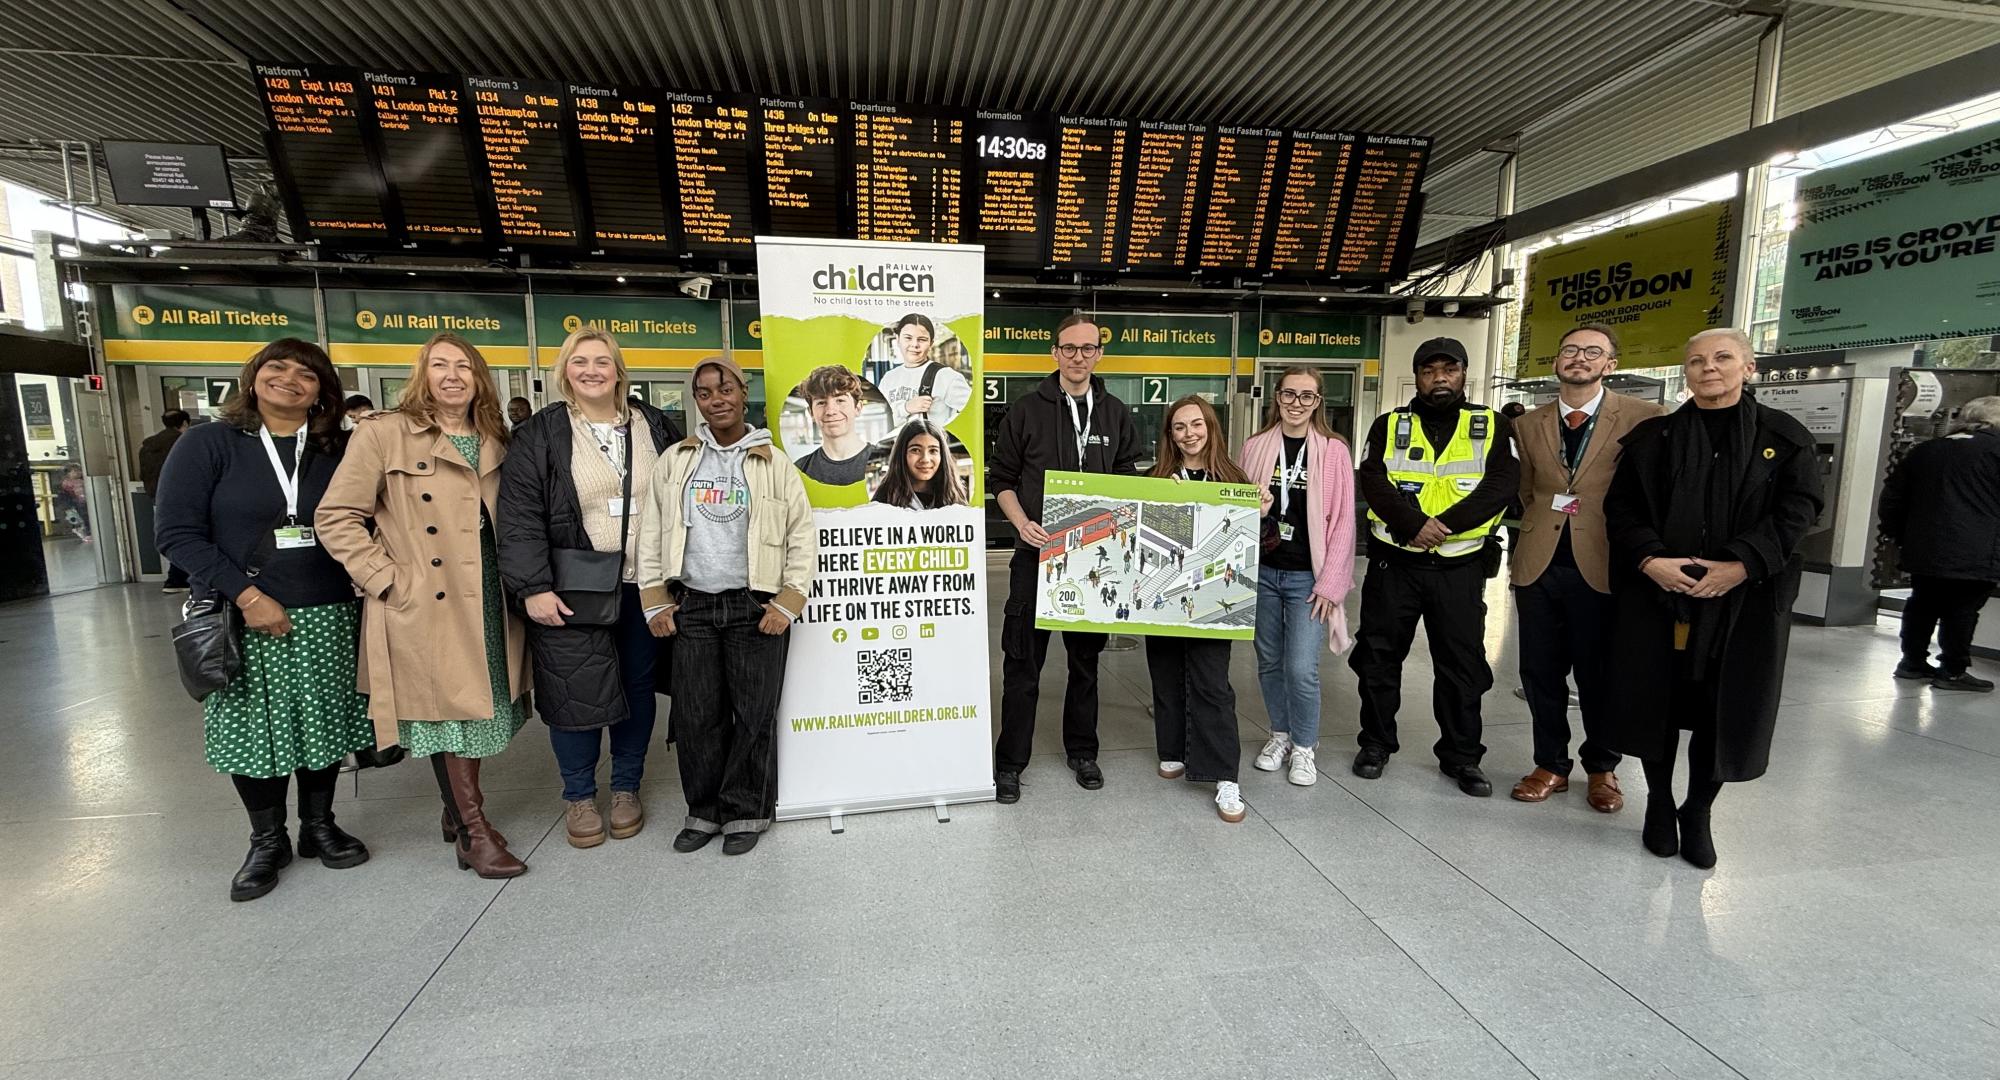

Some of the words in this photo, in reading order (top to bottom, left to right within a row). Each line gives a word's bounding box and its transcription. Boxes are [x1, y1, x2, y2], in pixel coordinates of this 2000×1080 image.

[256, 66, 301, 76] Platform
[304, 68, 310, 77] 1
[364, 72, 407, 84] Platform
[410, 77, 416, 85] 2
[264, 78, 290, 89] 1428
[301, 80, 324, 92] Expt
[329, 82, 354, 92] 1433
[468, 78, 510, 89] Platform
[512, 81, 519, 90] 3
[570, 85, 610, 96] Platform
[612, 89, 618, 97] 4
[267, 92, 303, 103] London
[306, 94, 344, 106] Victoria
[372, 85, 395, 96] 1431
[428, 89, 447, 100] Plat
[451, 91, 458, 100] 2
[476, 91, 498, 102] 1434
[525, 95, 537, 105] On
[540, 96, 558, 106] time
[667, 92, 704, 102] Platform
[707, 95, 712, 103] 5
[375, 99, 389, 109] via
[392, 100, 425, 112] London
[428, 103, 458, 115] Bridge
[576, 98, 598, 108] 1438
[624, 101, 634, 111] On
[638, 102, 656, 112] time
[760, 98, 796, 108] Platform
[851, 102, 896, 113] Departures
[477, 105, 538, 118] Littlehampton
[576, 111, 608, 122] London
[611, 113, 638, 125] Bridge
[672, 104, 693, 114] 1452
[717, 107, 728, 116] On
[731, 107, 748, 118] time
[764, 110, 785, 120] 1436
[808, 112, 818, 121] On
[822, 112, 838, 123] time
[977, 110, 1021, 120] Information
[672, 117, 702, 128] London
[704, 119, 731, 130] Bridge
[734, 121, 746, 131] via
[764, 122, 785, 132] Three
[788, 124, 814, 135] Bridges
[817, 126, 828, 135] via
[1060, 116, 1077, 124] Next
[1080, 117, 1107, 126] Fastest
[1109, 118, 1127, 127] Train
[1140, 120, 1158, 129] Next
[1159, 122, 1186, 131] Fastest
[1188, 124, 1206, 132] Train
[1218, 126, 1235, 134] Next
[1237, 127, 1263, 136] Fastest
[1265, 128, 1282, 137] Train
[1293, 130, 1309, 139] Next
[1311, 132, 1336, 140] Fastest
[1338, 133, 1355, 142] Train
[1384, 136, 1409, 145] Fastest
[1411, 138, 1428, 146] Train
[1866, 174, 1930, 192] CROYDON
[1800, 243, 1859, 267] THIS
[1865, 237, 1891, 256] IS
[1897, 214, 2000, 248] CROYD
[1814, 259, 1872, 282] AND
[1879, 236, 1996, 270] YOU'RE
[812, 264, 934, 292] children
[1547, 269, 1601, 296] THIS
[1608, 262, 1632, 282] IS
[1560, 268, 1693, 312] CROYDON
[830, 297, 851, 305] child
[855, 297, 871, 306] lost
[162, 309, 183, 324] All
[188, 310, 220, 325] Rail
[225, 311, 288, 326] Tickets
[1575, 308, 1615, 322] LONDON
[1618, 299, 1671, 315] BOROUGH
[1796, 308, 1840, 319] CROYDON
[383, 315, 403, 328] All
[408, 315, 438, 329] Rail
[442, 316, 500, 330] Tickets
[611, 320, 638, 333] Rail
[643, 321, 697, 334] Tickets
[984, 327, 1000, 340] ail
[1004, 328, 1051, 340] Tickets
[1121, 329, 1138, 342] All
[1143, 329, 1167, 343] Rail
[1171, 330, 1216, 344] Tickets
[1277, 332, 1291, 343] All
[1295, 333, 1316, 344] Rail
[1319, 333, 1360, 345] Tickets
[91, 376, 100, 389] 7
[1761, 370, 1808, 382] Tickets
[212, 382, 231, 404] 7
[629, 385, 643, 400] 5
[985, 380, 998, 399] 3
[1149, 380, 1162, 402] 2
[819, 527, 883, 547] BELIEVE
[888, 526, 902, 545] IN
[907, 526, 917, 544] A
[920, 525, 974, 543] WORLD
[818, 553, 859, 573] HERE
[866, 551, 915, 571] EVERY
[919, 549, 964, 569] CHILD
[827, 577, 884, 597] THRIVE
[888, 575, 928, 595] AWAY
[933, 573, 975, 592] FROM
[1059, 591, 1075, 601] 200
[808, 604, 842, 624] LIFE
[846, 603, 866, 621] ON
[871, 601, 900, 620] THE
[905, 598, 975, 617] STREETS.
[791, 705, 977, 732] WWW.RAILWAYCHILDREN.ORG.UK
